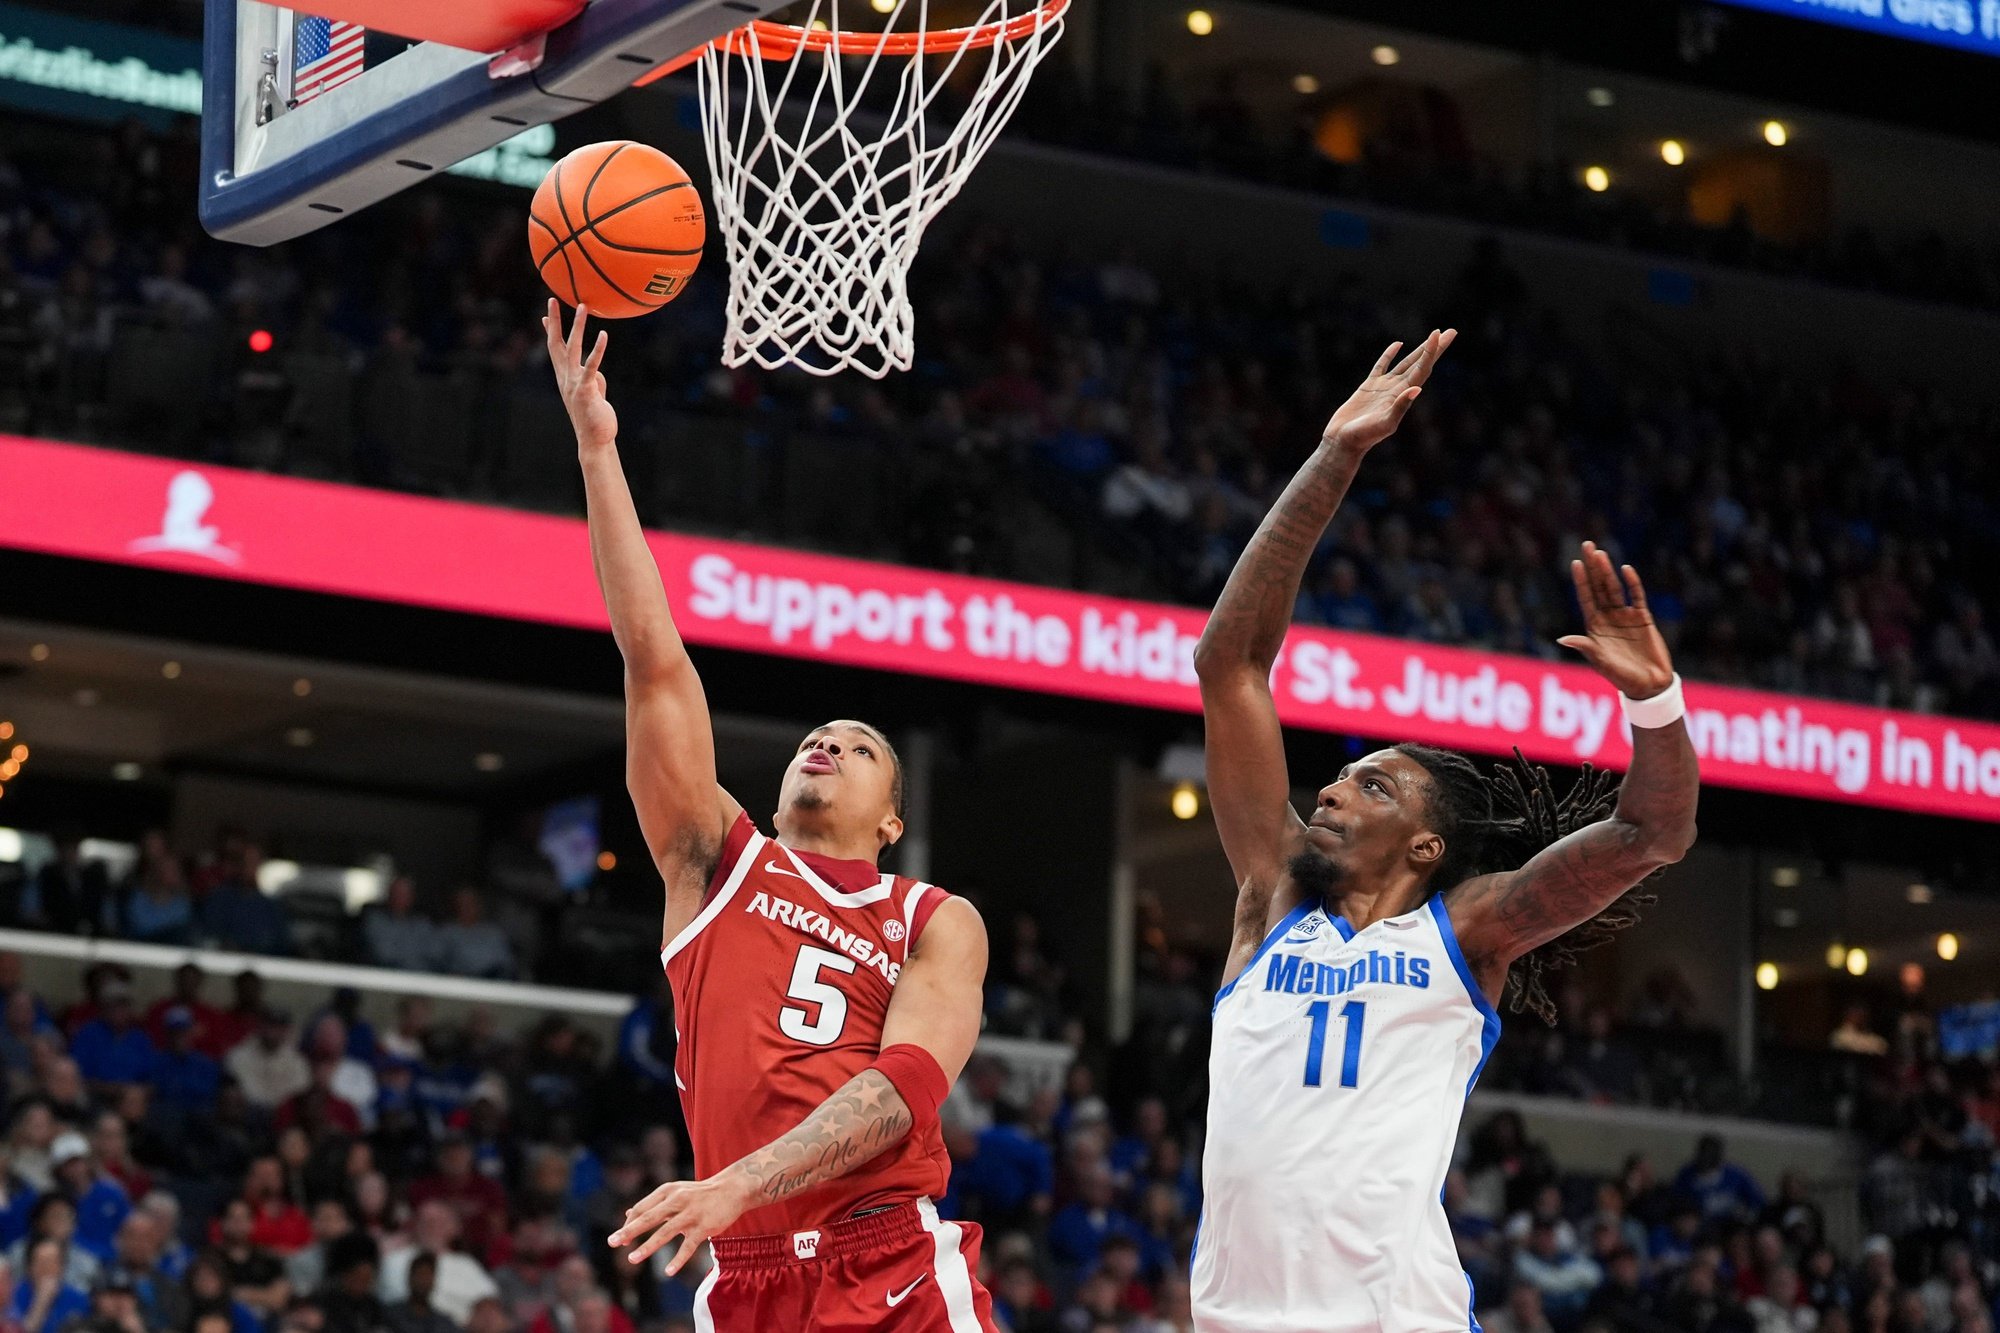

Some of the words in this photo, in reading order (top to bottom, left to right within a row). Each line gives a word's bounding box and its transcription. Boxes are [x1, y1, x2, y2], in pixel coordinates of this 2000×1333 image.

[689, 554, 954, 651] Support
[962, 595, 1071, 667] the
[1289, 639, 1374, 711] St.
[1381, 656, 1532, 732] Jude
[1540, 672, 1613, 757] by
[1620, 706, 1870, 794] nating
[1881, 719, 1932, 789] in
[745, 891, 901, 987] ARKANSAS
[884, 920, 904, 940] SEC
[778, 944, 857, 1046] 5
[1263, 950, 1431, 996] Memphis
[1303, 1000, 1367, 1090] 11
[764, 1165, 814, 1203] Fear
[818, 1137, 859, 1171] No
[797, 1237, 817, 1251] AR
